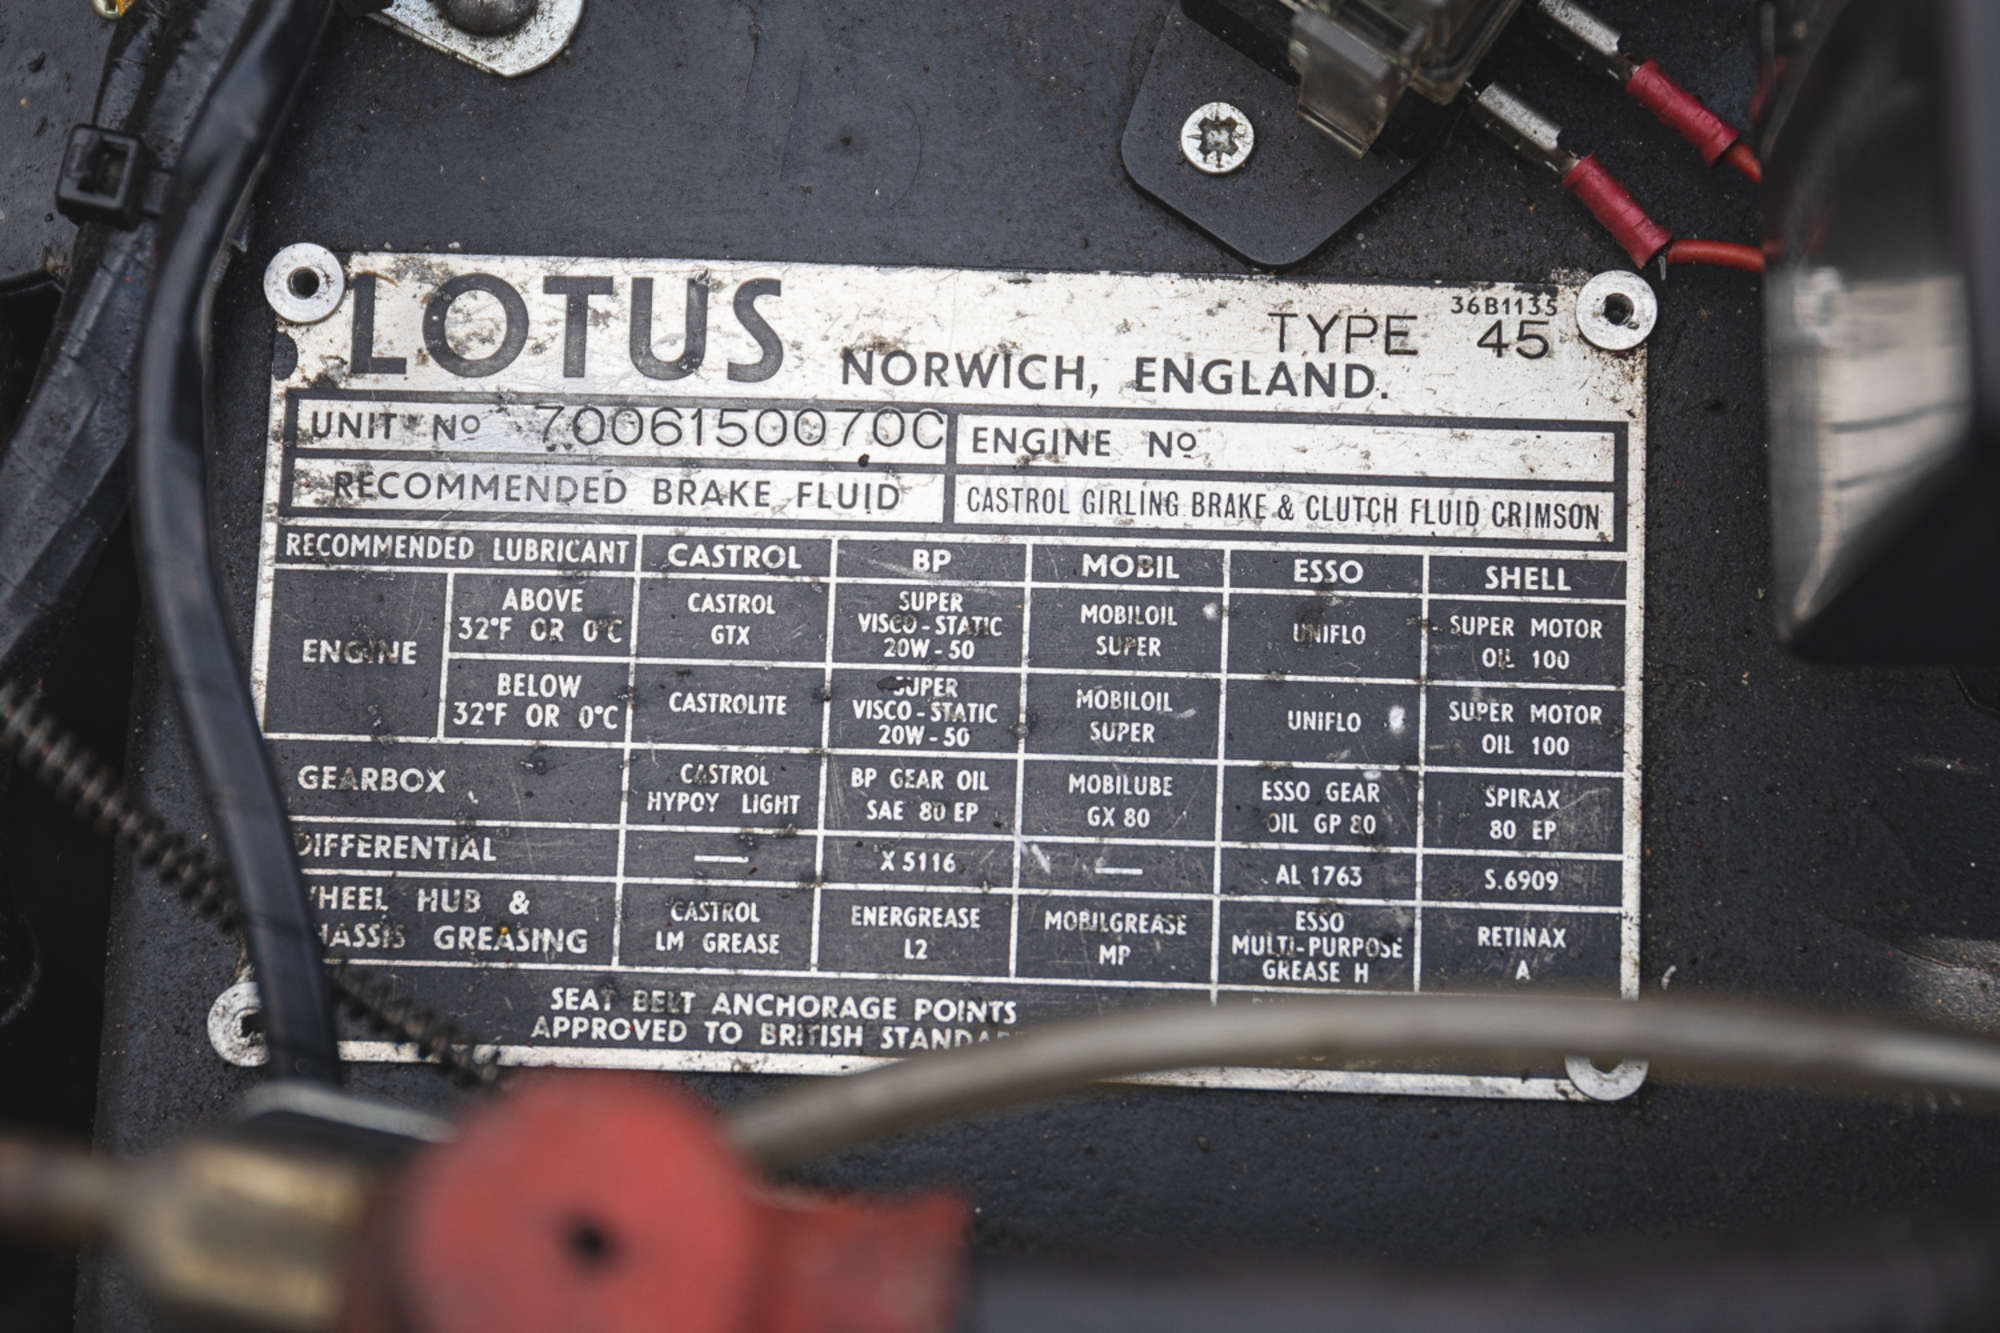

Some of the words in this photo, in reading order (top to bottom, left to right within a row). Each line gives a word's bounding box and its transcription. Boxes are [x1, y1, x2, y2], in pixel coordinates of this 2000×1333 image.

[1450, 295, 1558, 316] 36B1135
[350, 272, 784, 382] LOTUS
[1267, 312, 1418, 356] TYPE
[1476, 319, 1549, 359] 45
[841, 348, 1099, 398] NORWICH,
[1134, 356, 1390, 400] ENGLAND.
[311, 411, 397, 439] UNIT
[972, 427, 1111, 458] ENGINE
[333, 471, 626, 505] RECOMMENDED
[653, 480, 771, 508] BRAKE
[800, 483, 900, 513] FLUID
[967, 486, 1070, 514] CASTROL
[1082, 489, 1182, 516] GIRLING
[1192, 490, 1266, 521] BRAKE
[1277, 496, 1296, 521] &
[1306, 494, 1398, 525] CLUTCH
[1410, 497, 1480, 529] FLUID
[1491, 501, 1600, 531] CRIMSON
[285, 532, 474, 560] RECOMMENDED
[493, 538, 630, 564] LUBRICANT
[667, 543, 802, 570] CASTROL
[912, 549, 952, 573] BP
[1081, 553, 1180, 580] MOBIL
[1293, 558, 1364, 584] ESSO
[1484, 565, 1572, 592] SHELL
[502, 587, 584, 613] ABOVE
[687, 592, 776, 616] CASTROL
[899, 591, 962, 614] SUPER
[1080, 604, 1178, 627] MOBILOIL
[1449, 615, 1515, 638] SUPER
[1530, 618, 1603, 640] MOTOR
[530, 618, 564, 643] OR
[710, 625, 750, 646] GTX
[1293, 623, 1367, 646] UNIFLO
[302, 639, 417, 665] ENGINE
[1096, 636, 1161, 657] SUPER
[1481, 647, 1515, 669] OIL
[1532, 650, 1570, 670] 100
[497, 673, 582, 699] BELOW
[668, 691, 788, 716] CASTROLITE
[1076, 688, 1174, 713] MOBILOIL
[1448, 700, 1514, 723] SUPER
[1530, 703, 1603, 725] MOTOR
[525, 704, 559, 729] OR
[1287, 710, 1362, 733] UNIFLO
[1089, 721, 1155, 744] SUPER
[1481, 734, 1515, 755] OIL
[1531, 736, 1570, 756] 100
[297, 764, 447, 793] GEARBOX
[680, 764, 770, 786] CASTROL
[850, 767, 877, 789] BP
[889, 769, 944, 790] GEAR
[957, 772, 990, 792] OIL
[1068, 772, 1173, 797] MOBILUBE
[647, 792, 720, 813] HYPOY
[741, 794, 801, 816] LIGHT
[1261, 780, 1311, 802] ESSO
[1325, 783, 1381, 803] GEAR
[1484, 788, 1561, 810] SPIRAX
[866, 800, 904, 821] SAE
[919, 802, 946, 822] 80
[954, 803, 979, 823] EP
[1087, 806, 1115, 828] GX
[1123, 807, 1151, 829] 80
[1267, 812, 1299, 834] OIL
[1313, 813, 1342, 834] GP
[1349, 814, 1377, 835] 80
[1489, 820, 1517, 840] 80
[1532, 820, 1558, 841] EP
[296, 832, 497, 863] DIFFERENTIAL
[880, 850, 895, 872] X
[902, 853, 957, 873] 5116
[1276, 864, 1301, 886] AL
[1311, 866, 1364, 887] 1763
[1484, 869, 1560, 892] S.6909
[416, 888, 482, 913] HUB
[508, 890, 531, 915] &
[670, 901, 761, 923] CASTROL
[850, 905, 982, 930] ENERGREASE
[1044, 910, 1188, 936] MOBILGREASE
[1295, 910, 1345, 933] ESSO
[433, 925, 588, 955] GREASING
[656, 931, 685, 951] LM
[703, 933, 781, 955] GREASE
[904, 939, 929, 960] L2
[1231, 934, 1404, 959] MULTI-PURPOSE
[1477, 926, 1567, 949] RETINAX
[1098, 945, 1132, 966] MP
[1262, 961, 1342, 983] GREASE
[1354, 963, 1370, 984] H
[1515, 959, 1531, 981] A
[551, 987, 613, 1012] SEAT
[632, 990, 697, 1015] BELT
[711, 993, 897, 1021] ANCHORAGE
[914, 998, 1017, 1025] POINTS
[531, 1015, 688, 1043] APPROVED
[704, 1021, 743, 1046] TO
[760, 1022, 864, 1050] BRITISH
